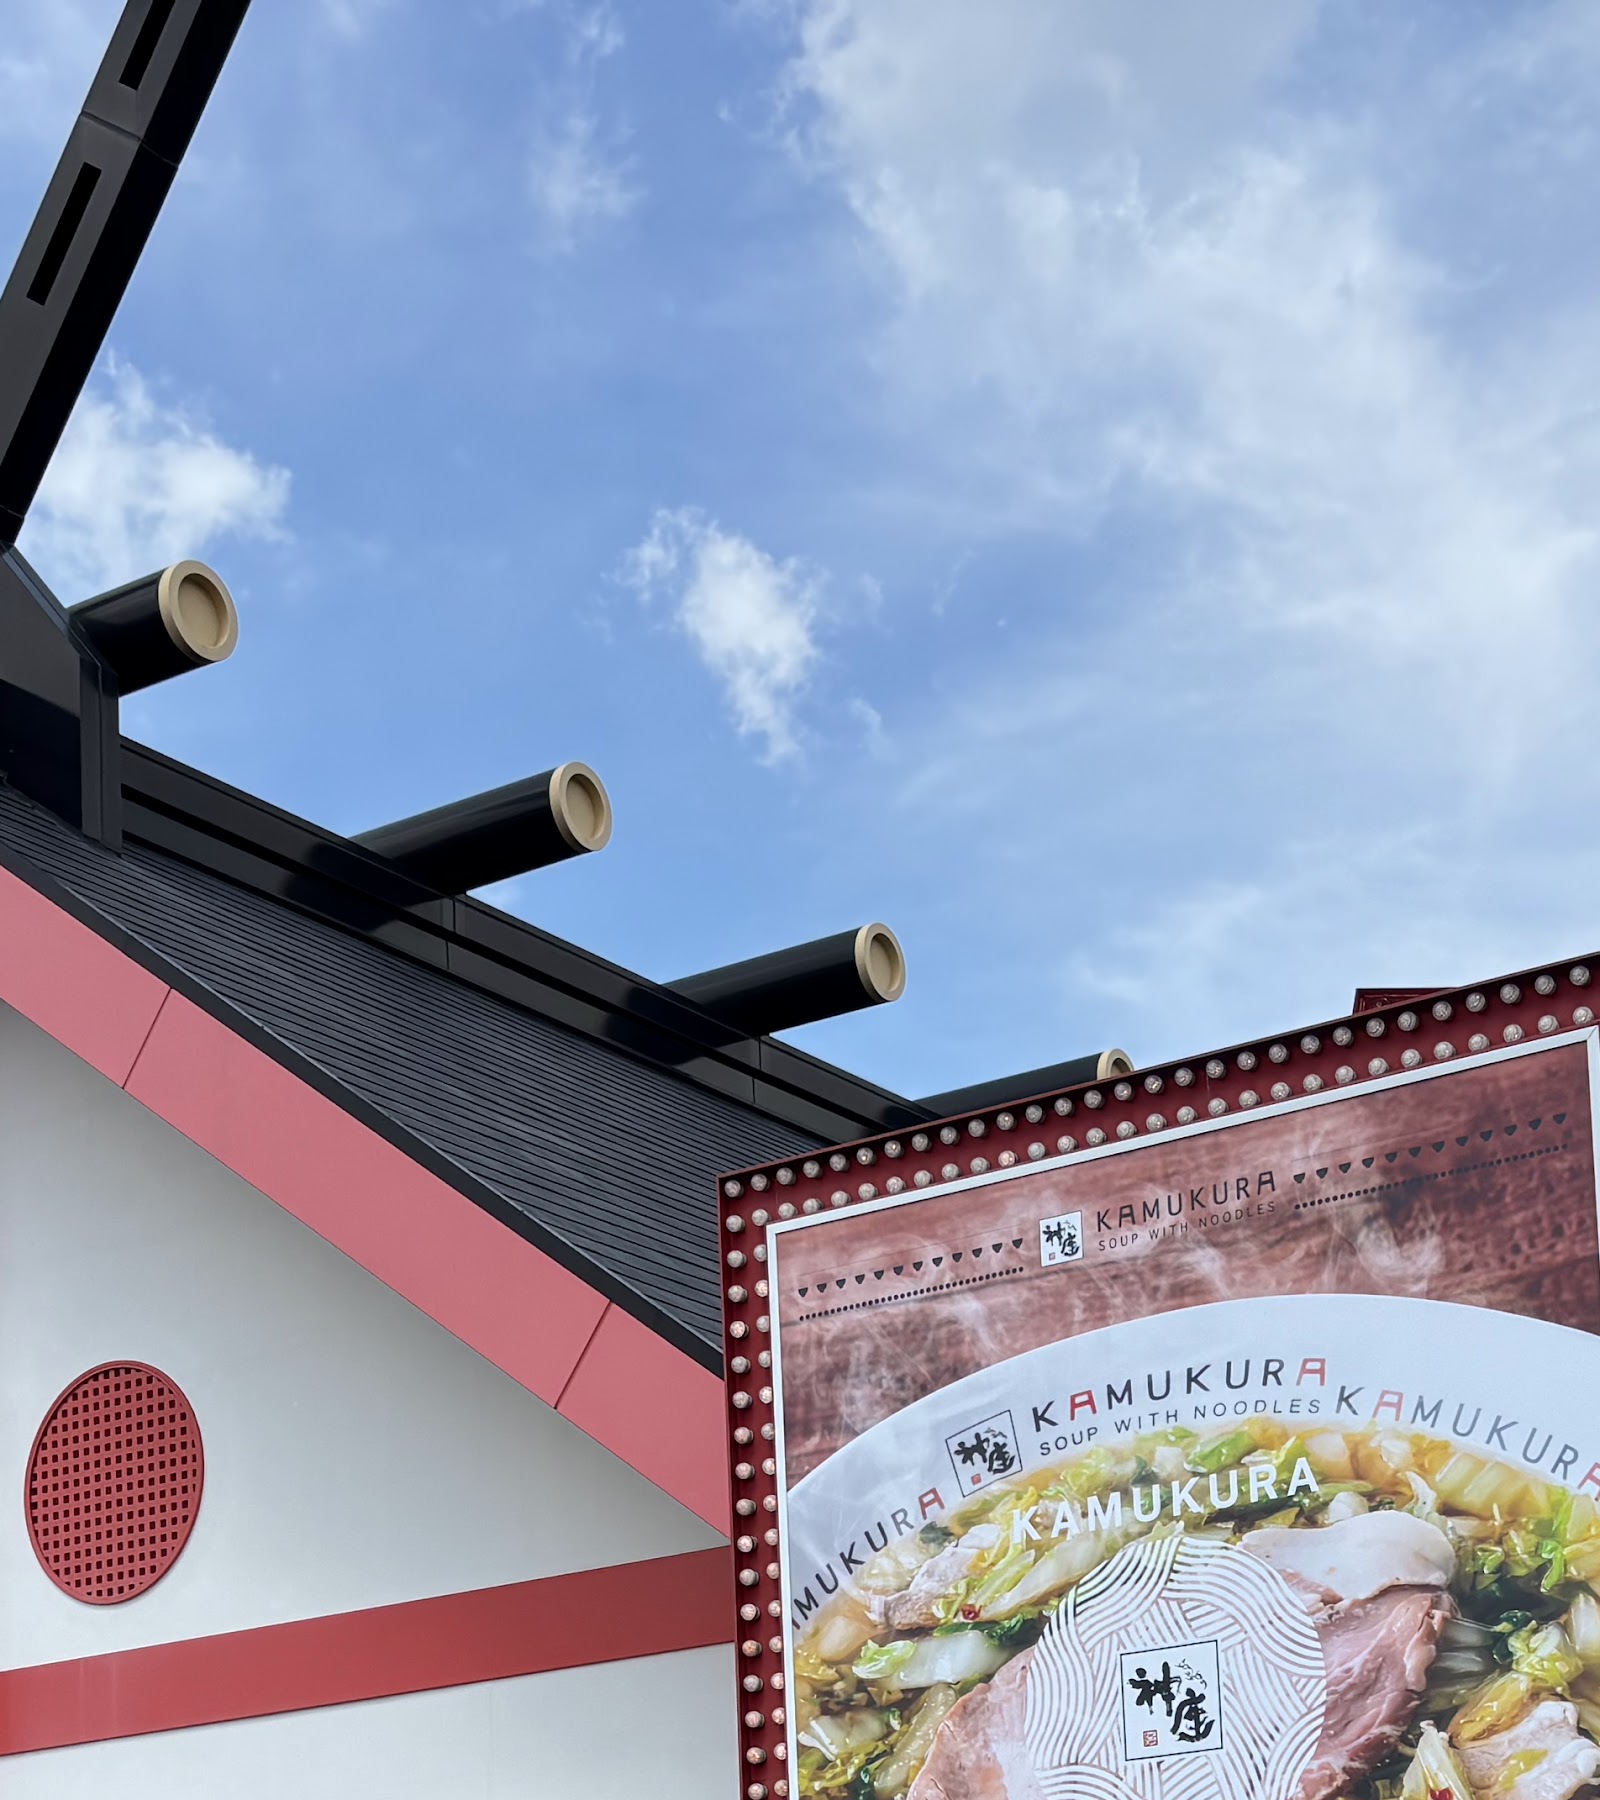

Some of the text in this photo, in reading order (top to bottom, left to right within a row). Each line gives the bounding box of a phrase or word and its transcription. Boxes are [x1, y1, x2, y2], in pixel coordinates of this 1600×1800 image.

[1097, 1171, 1276, 1232] KAMUKURA
[1099, 1201, 1276, 1251] SOUP WITH NOODLES
[1032, 1357, 1327, 1432] KAMUKURA
[1040, 1399, 1320, 1456] SOUP WITH NOODLES
[1010, 1456, 1320, 1544] KAMUKURA
